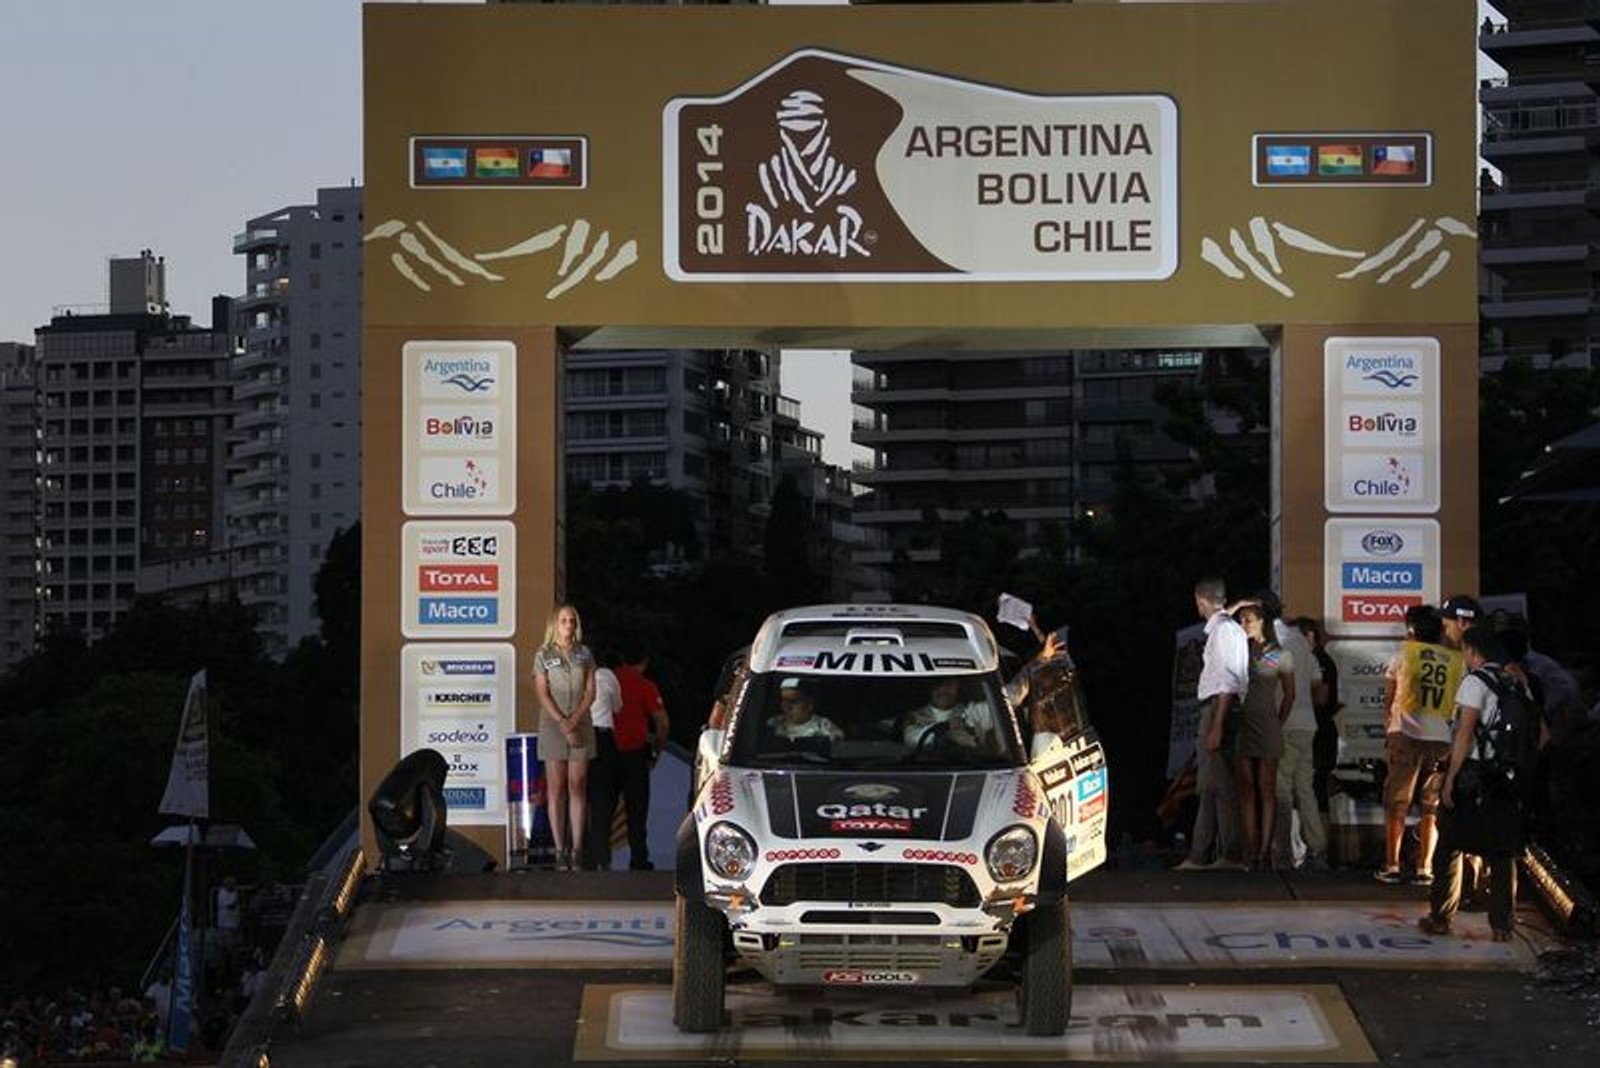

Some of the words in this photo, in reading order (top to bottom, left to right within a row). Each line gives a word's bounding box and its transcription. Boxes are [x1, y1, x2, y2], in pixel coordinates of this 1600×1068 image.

[905, 123, 1152, 158] ARGENTINA
[697, 125, 723, 255] 2014
[978, 172, 1151, 205] BOLIVIA
[746, 202, 871, 257] DAKAR
[1034, 220, 1152, 252] CHILE
[424, 358, 491, 375] Argentina
[1346, 354, 1413, 372] Argentina
[426, 417, 493, 435] Bolivia
[1349, 413, 1417, 432] Bolivia
[431, 482, 476, 498] Chile
[1354, 480, 1400, 495] Chile
[1370, 536, 1394, 546] FOX
[425, 570, 493, 585] TOTAL
[1351, 567, 1412, 583] Macro
[429, 602, 489, 618] Macro
[814, 652, 935, 672] MINI
[1421, 663, 1448, 685] 26
[1420, 685, 1446, 709] TV
[427, 729, 489, 743] sodexo
[816, 803, 928, 819] Qatar
[840, 820, 908, 830] TOTAL
[434, 916, 667, 932] Argenti
[1204, 930, 1434, 950] Chile
[864, 972, 915, 982] TOOLS
